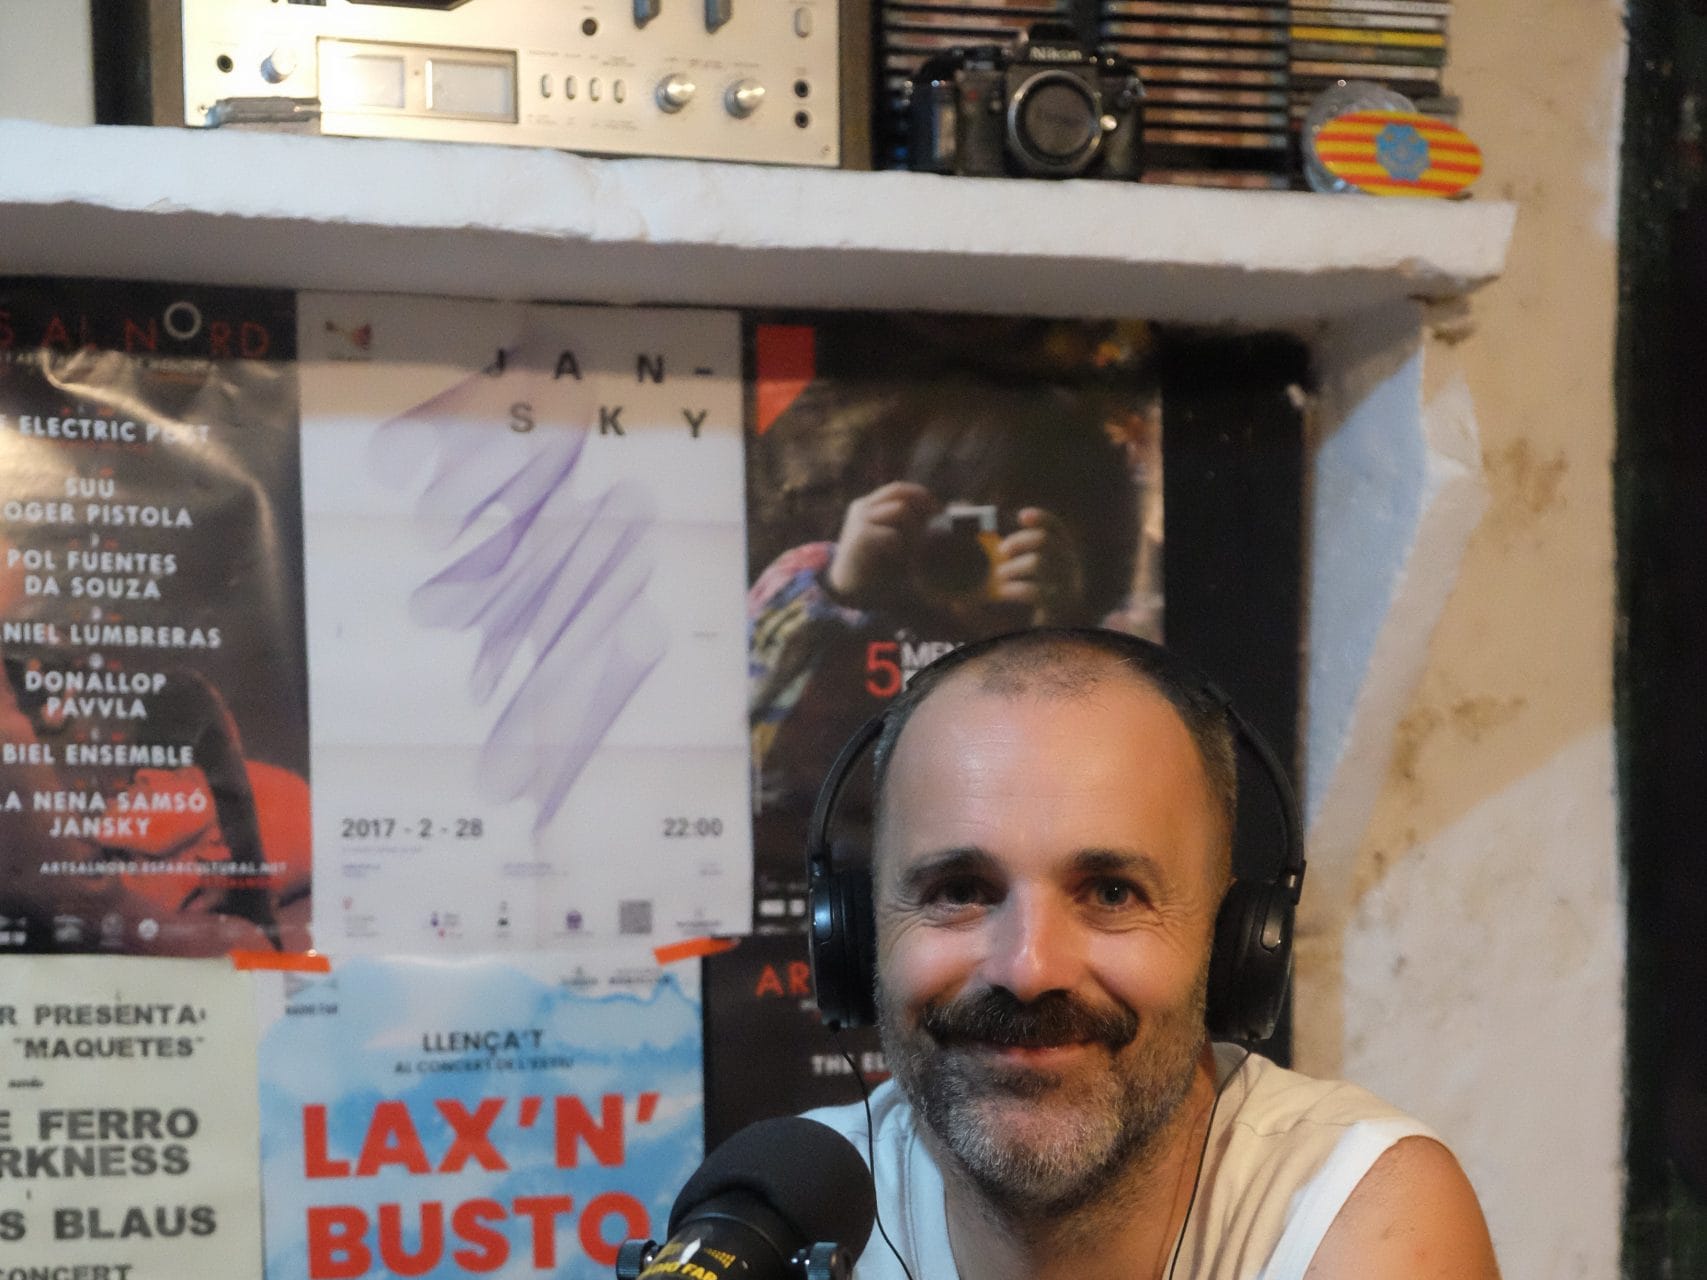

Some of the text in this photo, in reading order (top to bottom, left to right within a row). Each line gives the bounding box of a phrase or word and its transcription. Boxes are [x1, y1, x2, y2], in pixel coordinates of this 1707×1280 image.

[1029, 46, 1083, 62] Nikon
[19, 415, 137, 442] ELECTRIC
[65, 478, 115, 499] SUU
[4, 502, 193, 528] OGER PISTOLA
[7, 549, 178, 575] POL FUENTES
[25, 574, 161, 599] DA SOUZA
[0, 621, 222, 648] NIEL LUMBRERAS
[25, 669, 168, 694] DONALLOP
[865, 640, 902, 698] 5
[46, 696, 148, 719] PAVVLA
[3, 742, 194, 767] BIEL ENSEMBLE
[33, 790, 107, 813] NENA
[49, 816, 151, 838] JANSKY
[341, 819, 396, 838] 2017
[455, 818, 483, 838] 28
[662, 818, 724, 838] 22:00
[38, 1107, 199, 1141] FERRO
[0, 1144, 190, 1179] RKNESS
[54, 1205, 217, 1241] BLAUS
